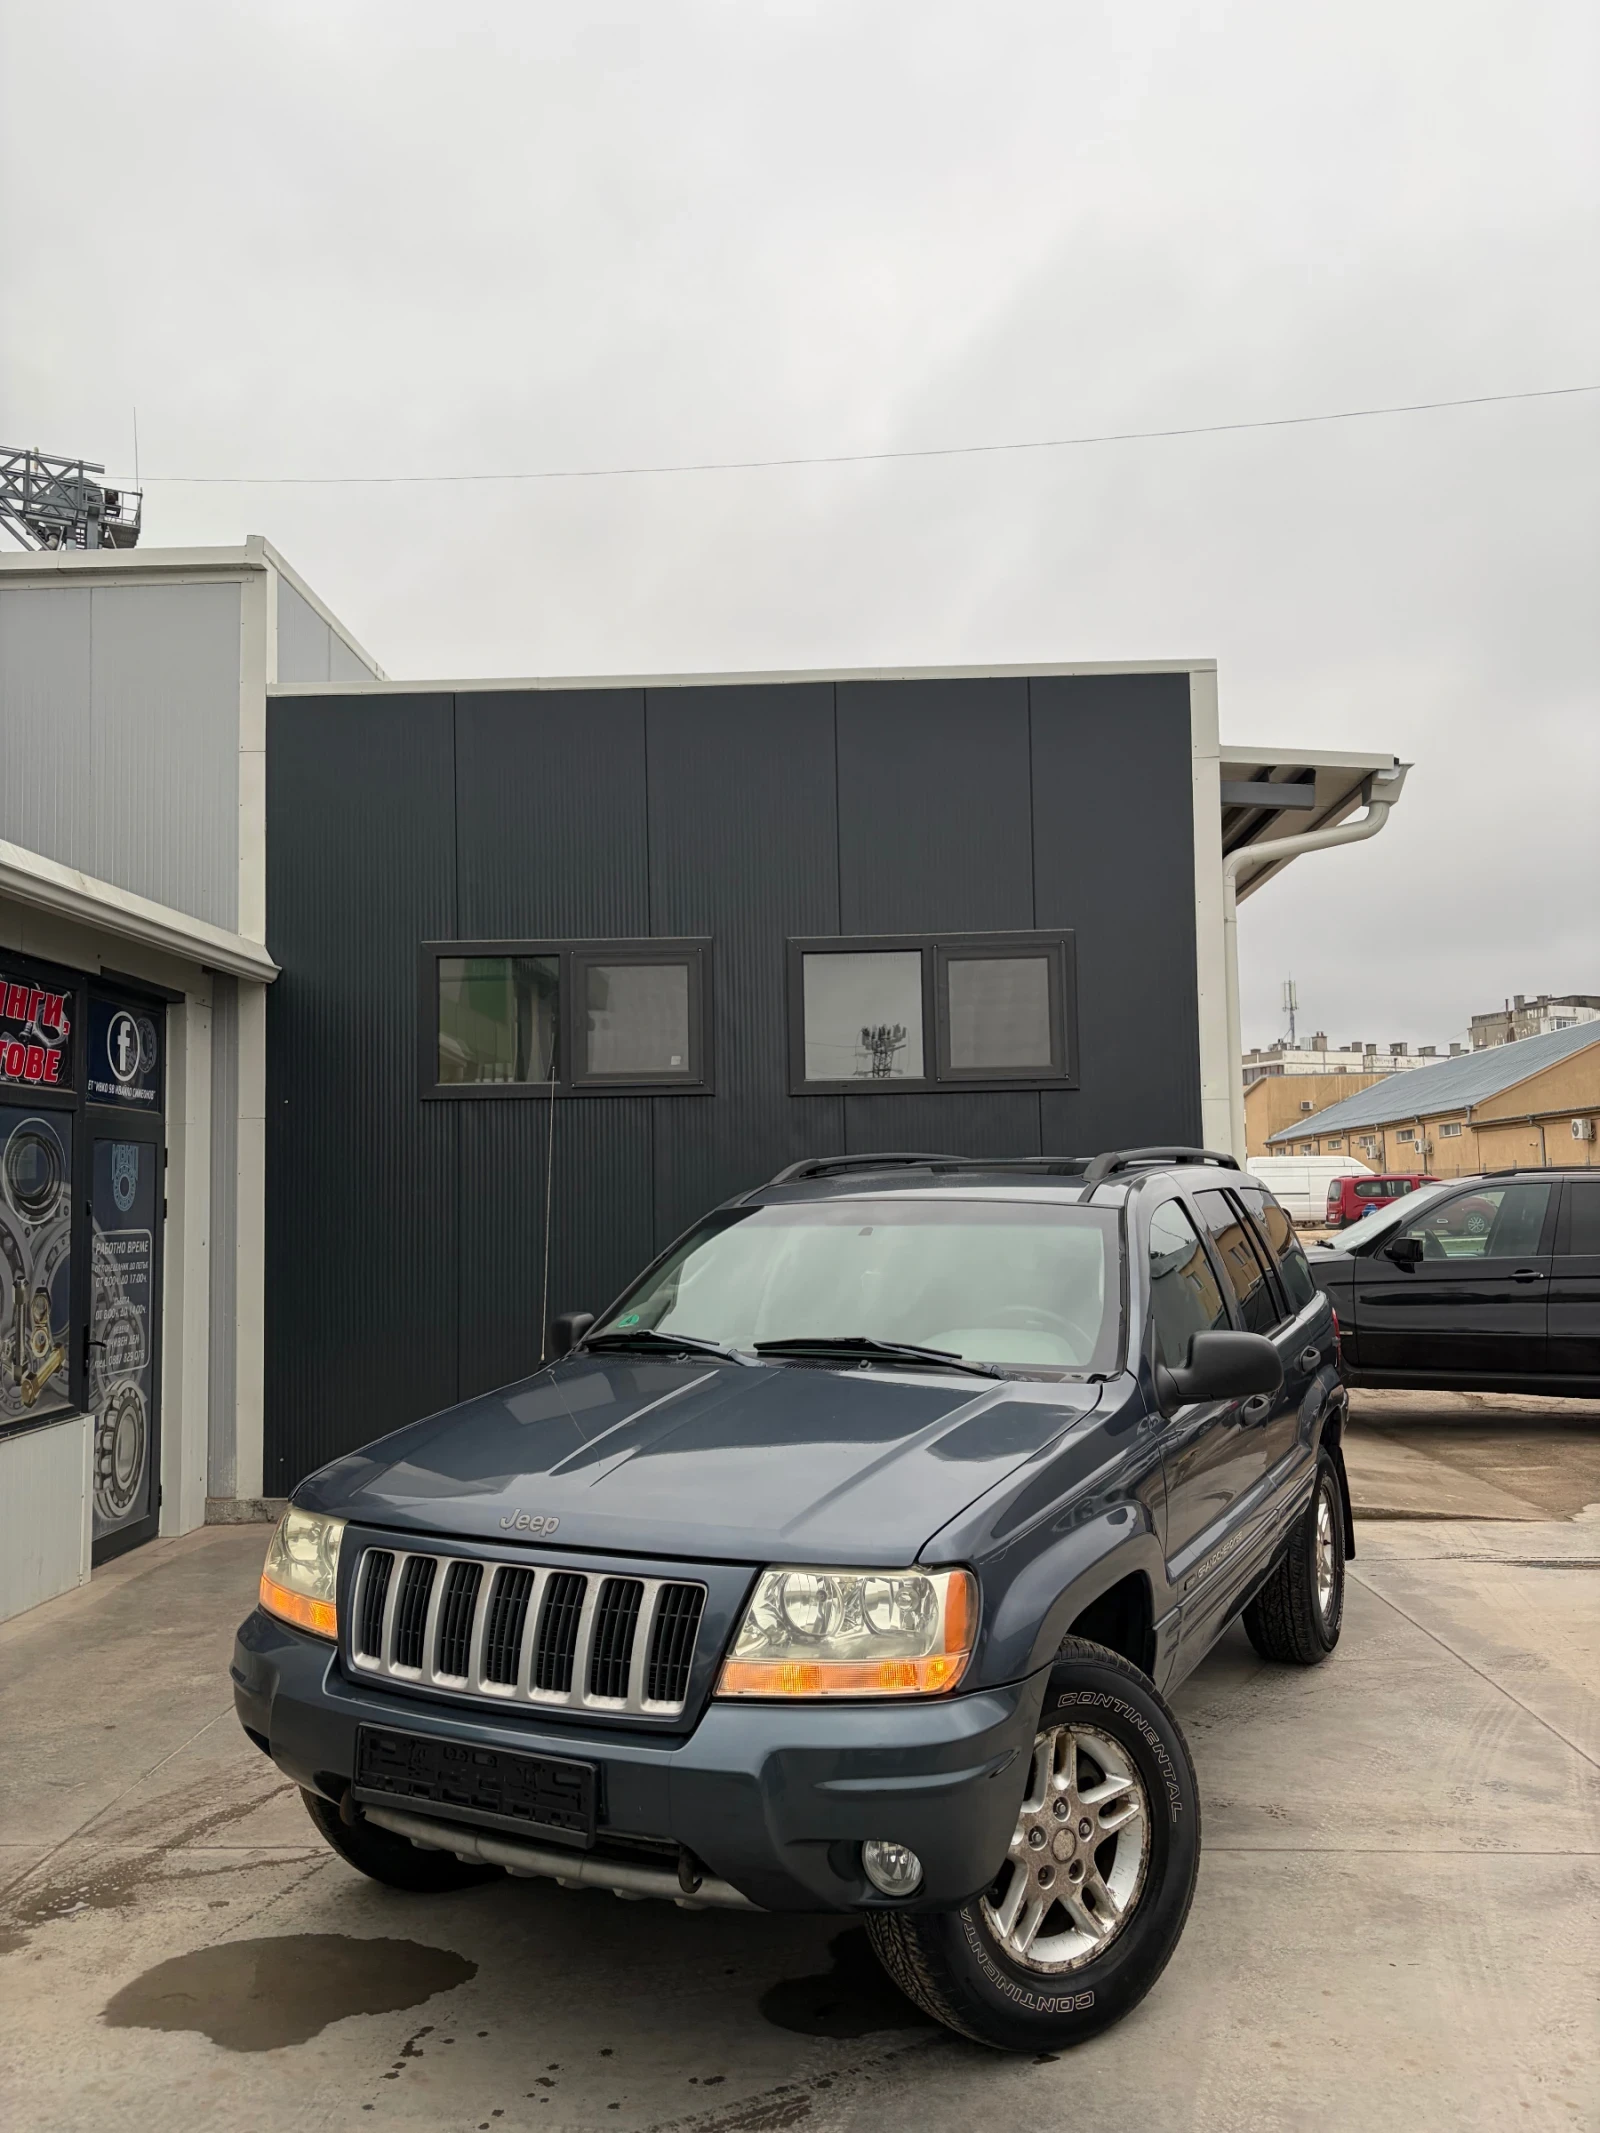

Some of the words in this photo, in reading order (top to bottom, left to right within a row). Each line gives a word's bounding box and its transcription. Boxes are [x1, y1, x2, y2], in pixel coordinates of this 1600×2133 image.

[95, 1241, 126, 1256] РАБОТНО
[127, 1240, 149, 1254] ВРЕМЕ
[499, 1507, 561, 1538] Jeep
[1057, 1690, 1183, 1824] CONTINENTAL
[959, 1906, 1096, 2014] CONTINENTA
